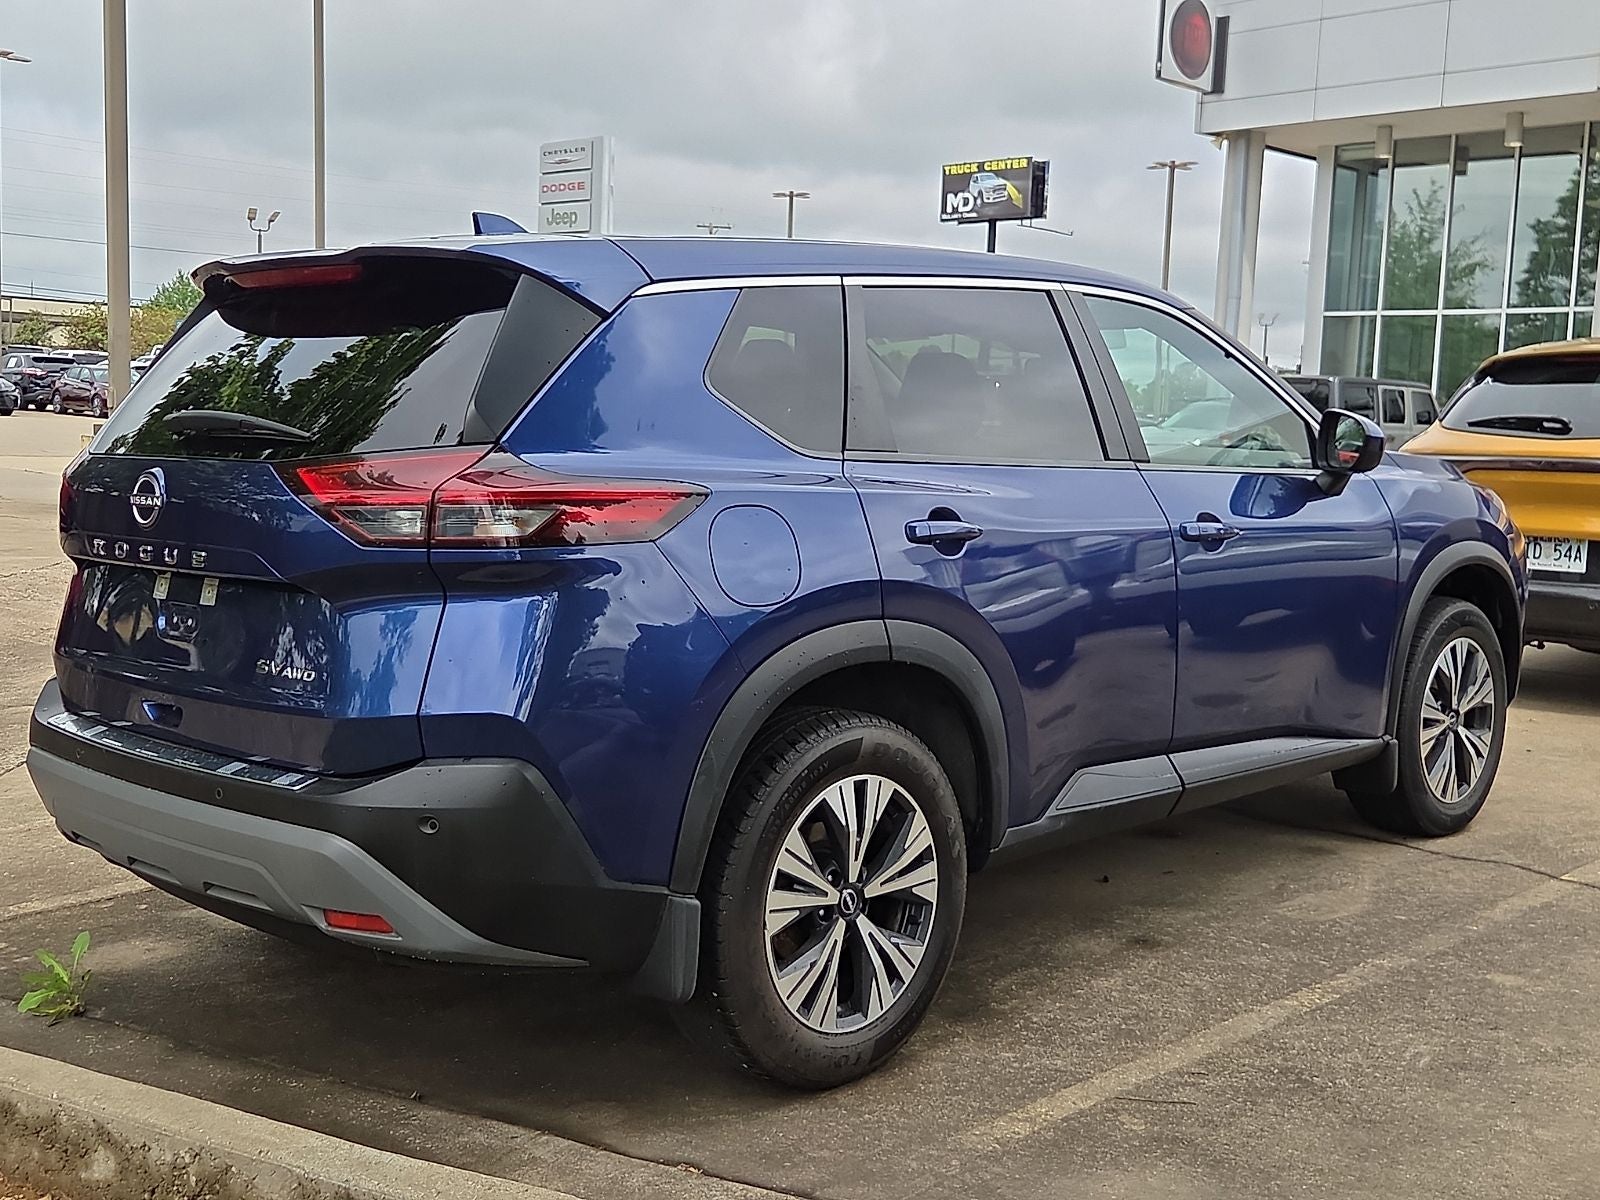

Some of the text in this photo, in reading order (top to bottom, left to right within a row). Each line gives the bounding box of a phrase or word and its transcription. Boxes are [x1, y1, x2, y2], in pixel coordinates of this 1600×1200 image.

[543, 147, 586, 157] CHRYSLER
[944, 158, 1028, 175] TRUCK CENTER
[541, 181, 585, 193] DODGE
[946, 192, 975, 213] MD
[546, 208, 578, 228] Jeep
[129, 495, 162, 506] NISSAN
[93, 538, 207, 568] ROGUE
[1553, 543, 1582, 563] 54A
[872, 741, 962, 860] DOUGLAS
